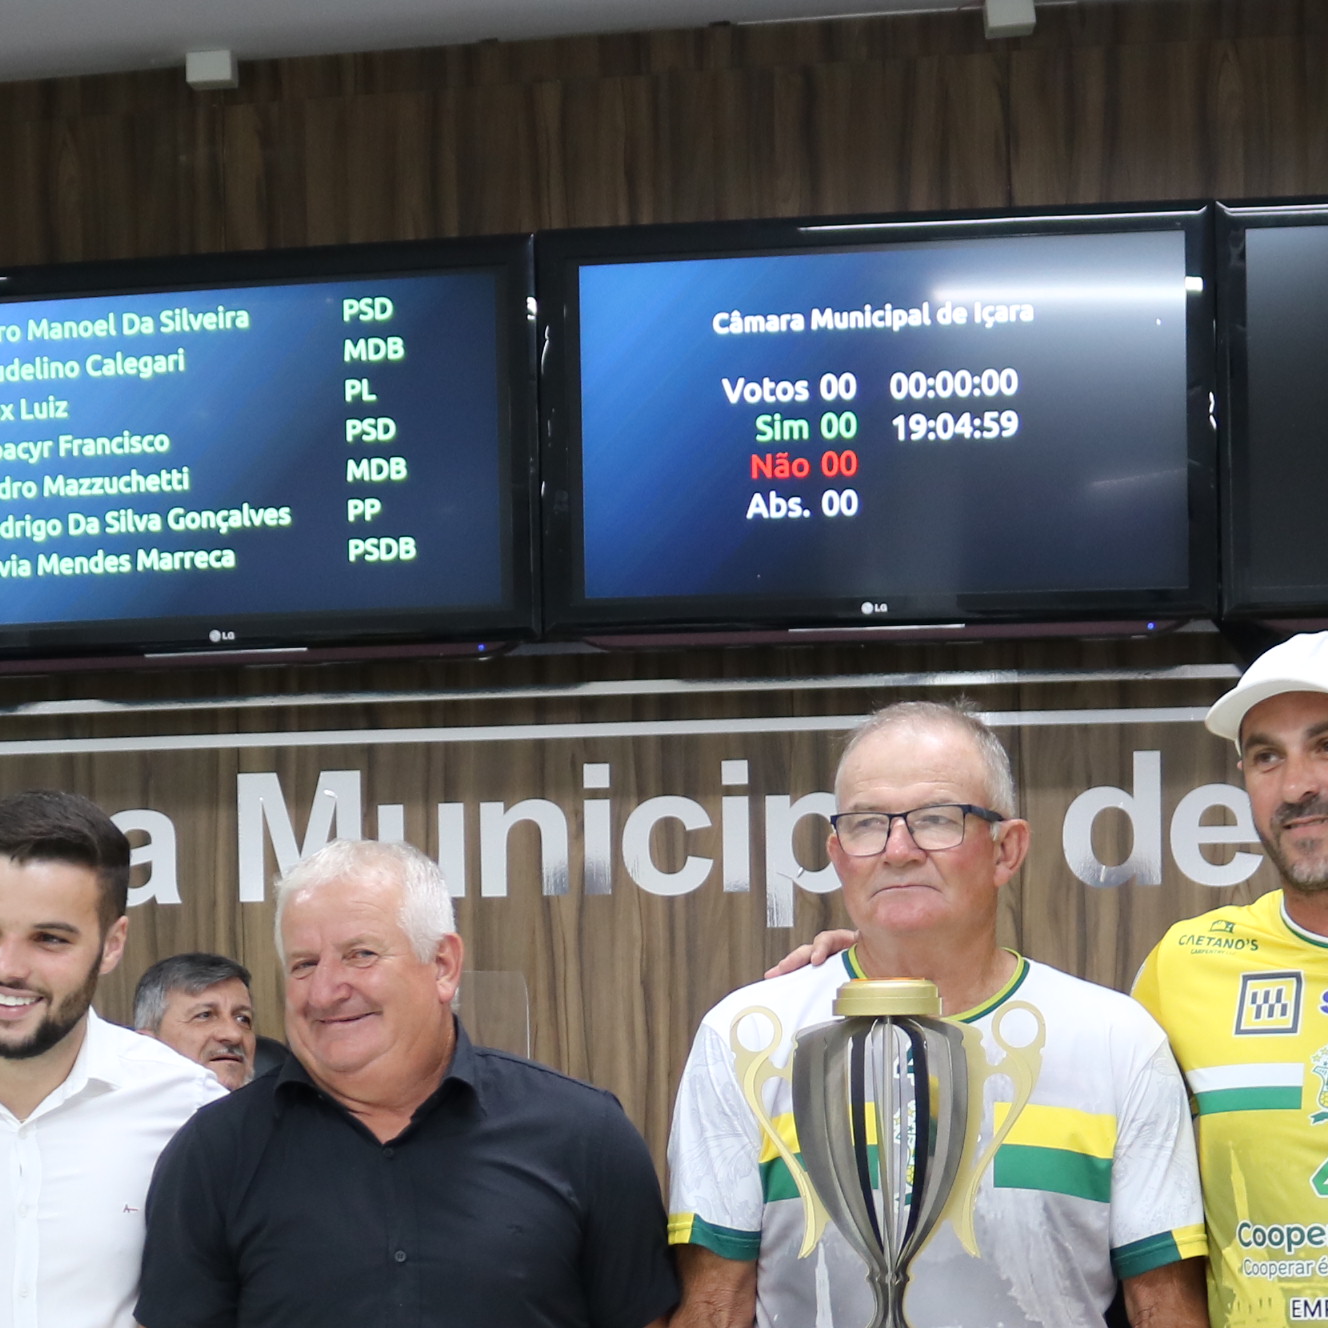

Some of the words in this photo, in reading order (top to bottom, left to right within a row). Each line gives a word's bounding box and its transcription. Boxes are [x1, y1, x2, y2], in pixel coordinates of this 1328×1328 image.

[342, 298, 393, 322] PSD
[712, 310, 804, 335] Câmara
[811, 303, 931, 332] Municipal
[936, 303, 968, 325] de
[974, 301, 1033, 328] Içara
[26, 314, 116, 342] Manoel
[122, 312, 154, 336] Da
[159, 308, 249, 334] Silveira
[86, 348, 185, 380] Calegari
[344, 338, 404, 362] MDB
[344, 380, 376, 402] PL
[722, 377, 809, 403] Votos
[820, 373, 857, 401] 00
[890, 369, 1018, 400] 00:00:00
[20, 396, 68, 420] Luiz
[346, 418, 396, 442] PSD
[756, 414, 809, 442] Sim
[821, 413, 857, 440] 00
[891, 411, 1019, 440] 19:04:59
[58, 430, 170, 458] Francisco
[346, 458, 407, 482] MDB
[751, 452, 809, 479] Não
[821, 451, 857, 478] 00
[43, 467, 190, 496] Mazzuchetti
[347, 500, 381, 522] PP
[746, 492, 811, 519] Abs.
[821, 490, 858, 517] 00
[68, 513, 100, 536] Da
[105, 508, 162, 534] Silva
[168, 503, 291, 534] Gonçalves
[37, 550, 131, 576] Mendes
[137, 548, 235, 572] Marreca
[348, 537, 416, 562] PSDB
[874, 603, 887, 612] LG
[222, 632, 234, 640] LG
[236, 760, 844, 928] Municip
[1062, 750, 1266, 888] de
[1243, 1259, 1314, 1280] Cooperar
[1318, 1257, 1328, 1274] é
